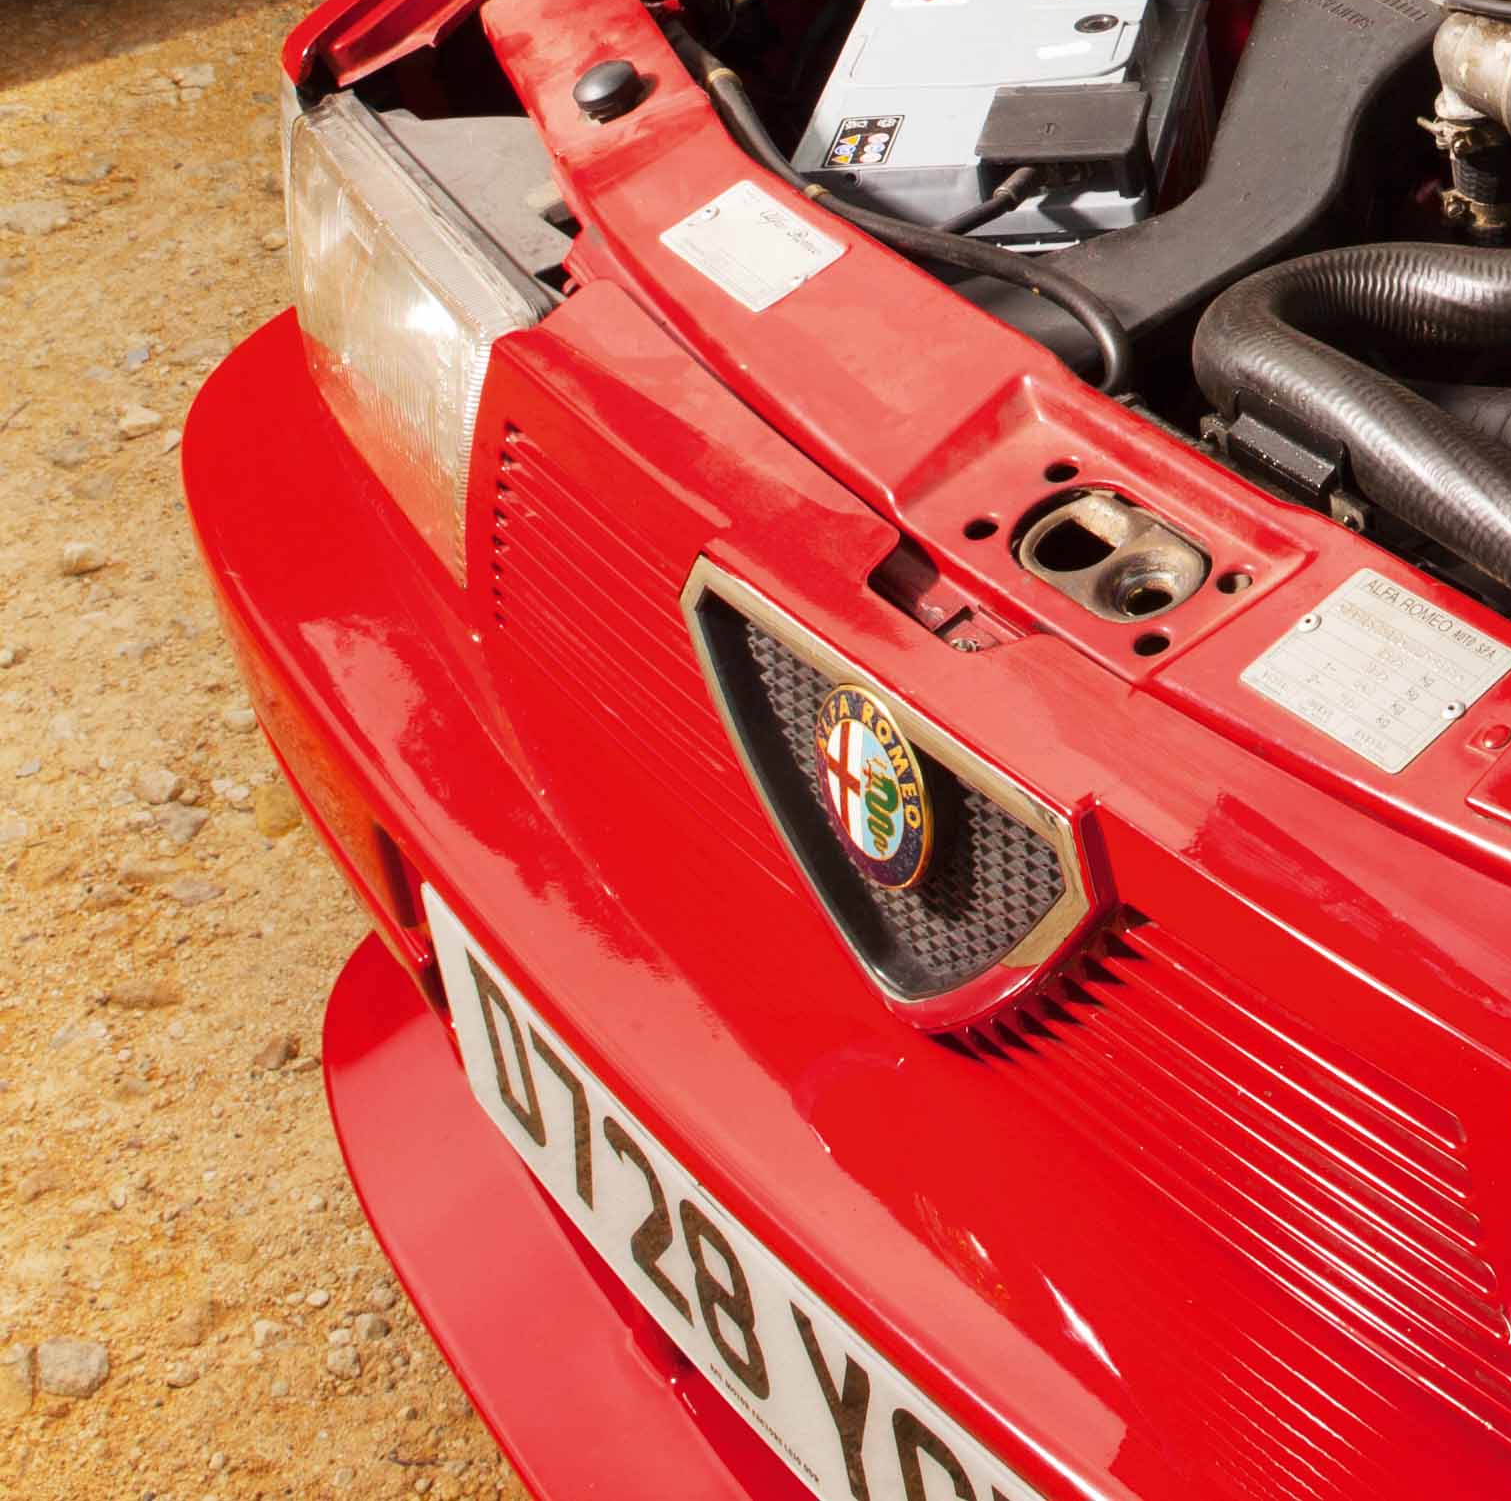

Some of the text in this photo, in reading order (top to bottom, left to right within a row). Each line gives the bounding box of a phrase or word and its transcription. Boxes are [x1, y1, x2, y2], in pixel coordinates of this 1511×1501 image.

[1365, 578, 1401, 605] ALFA
[1399, 595, 1454, 633] ROMEO
[818, 693, 922, 831] ALFA ROMEO
[464, 945, 771, 1401] D728
